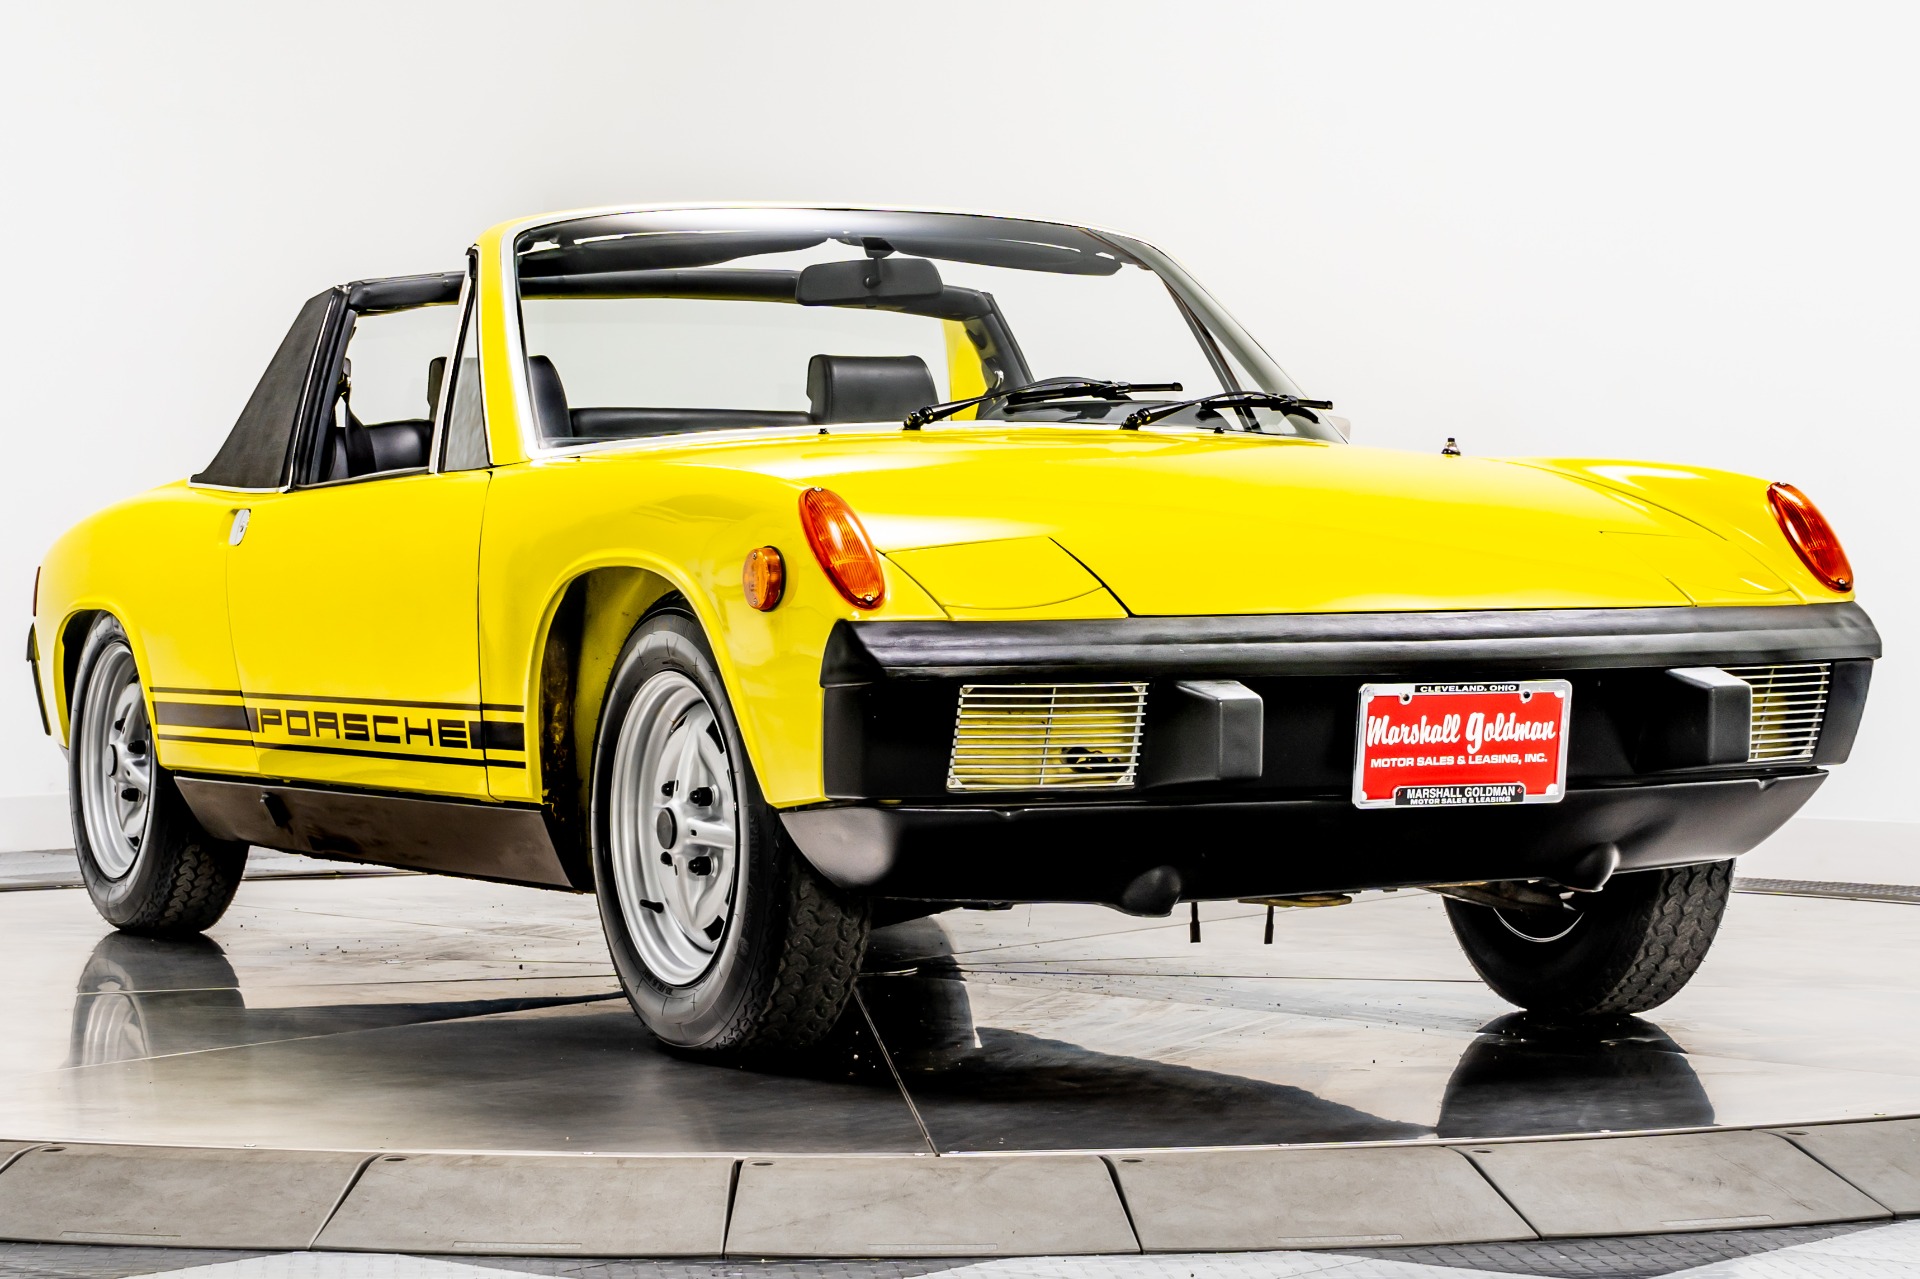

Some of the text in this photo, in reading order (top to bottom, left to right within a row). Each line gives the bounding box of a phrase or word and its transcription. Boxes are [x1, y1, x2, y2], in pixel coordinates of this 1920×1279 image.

[1489, 684, 1517, 692] OHIO
[259, 708, 468, 749] PORSCHE
[1366, 712, 1556, 754] Marshall Goldman
[1370, 753, 1548, 768] MOTOR SALES & LEASING, INC.
[1406, 786, 1515, 799] MARSHALL GOLDMAN
